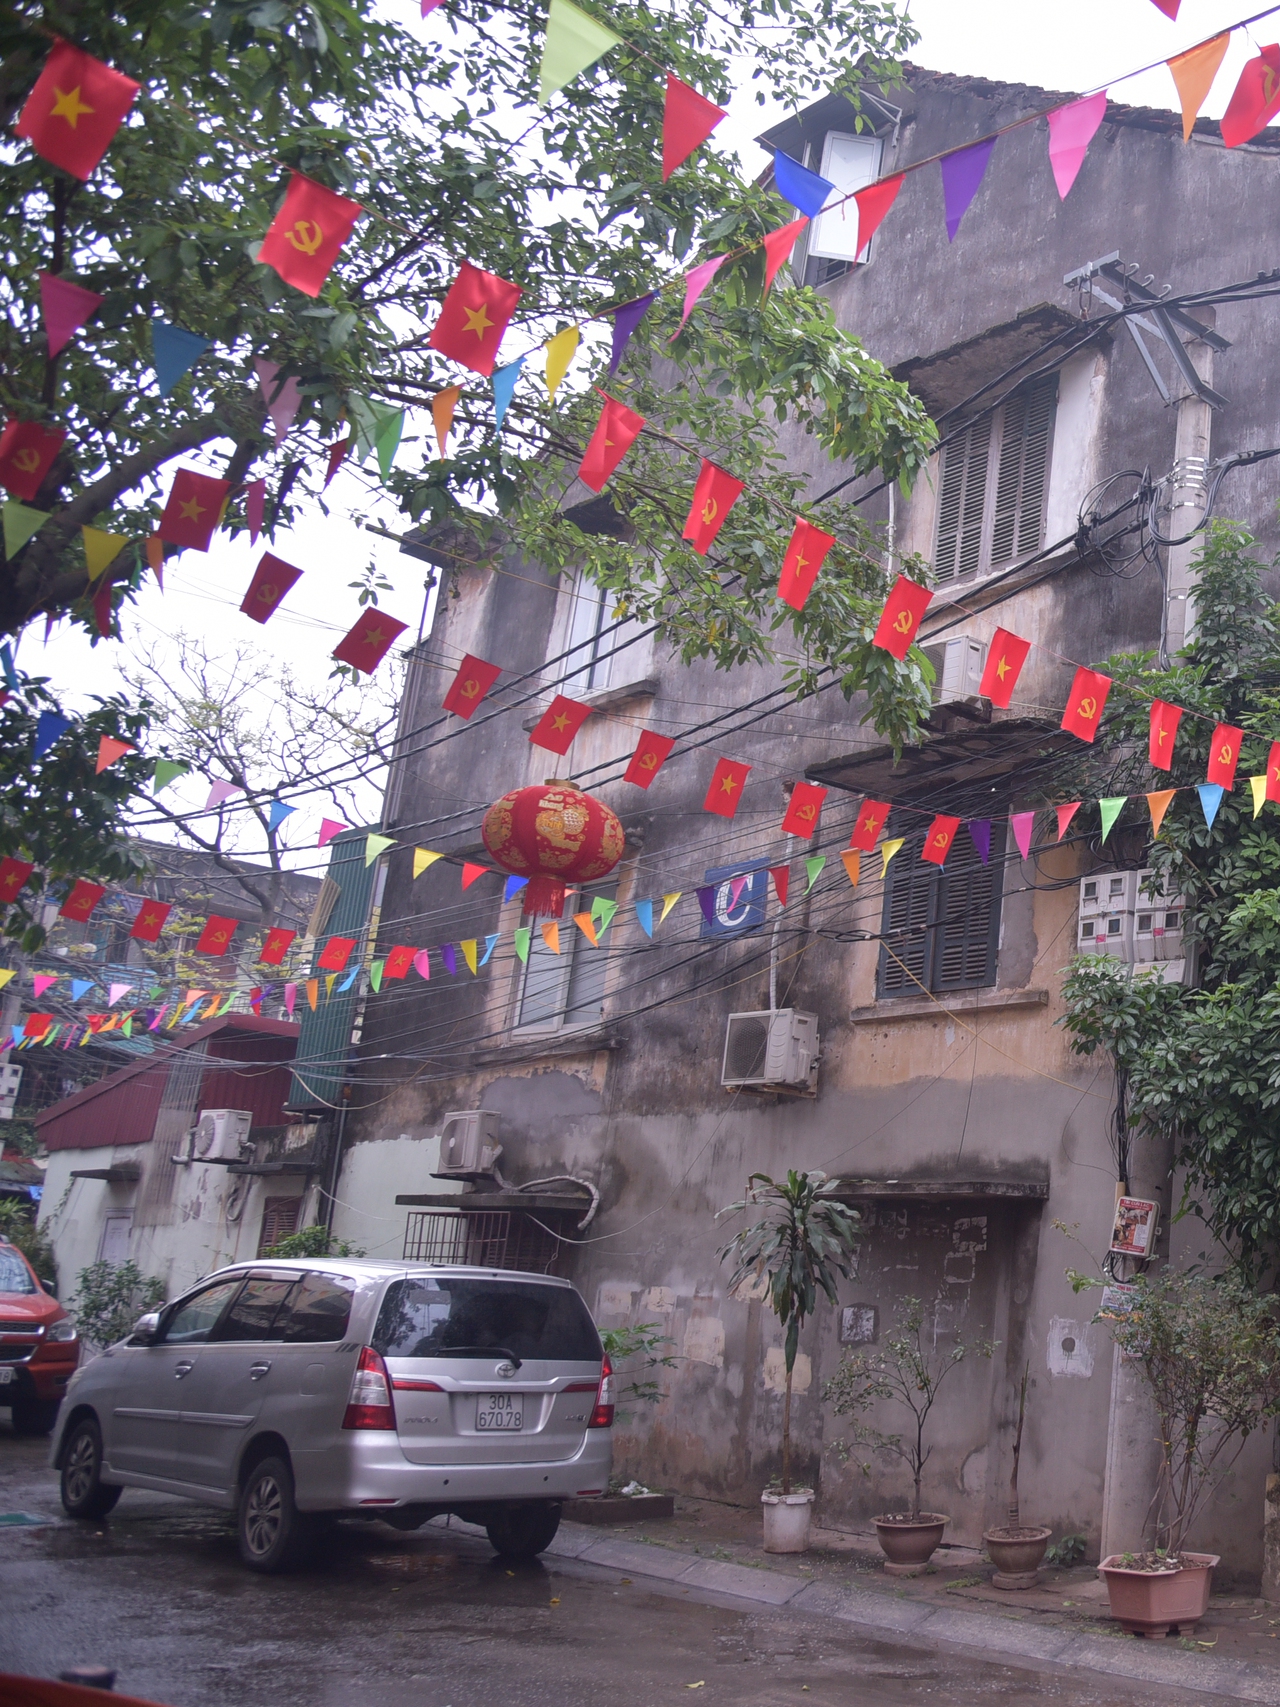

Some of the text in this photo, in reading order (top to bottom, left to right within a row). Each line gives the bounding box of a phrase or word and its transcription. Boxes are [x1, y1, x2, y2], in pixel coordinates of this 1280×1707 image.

[716, 872, 754, 926] C
[489, 1394, 512, 1410] 30A
[479, 1411, 522, 1427] 670.78
